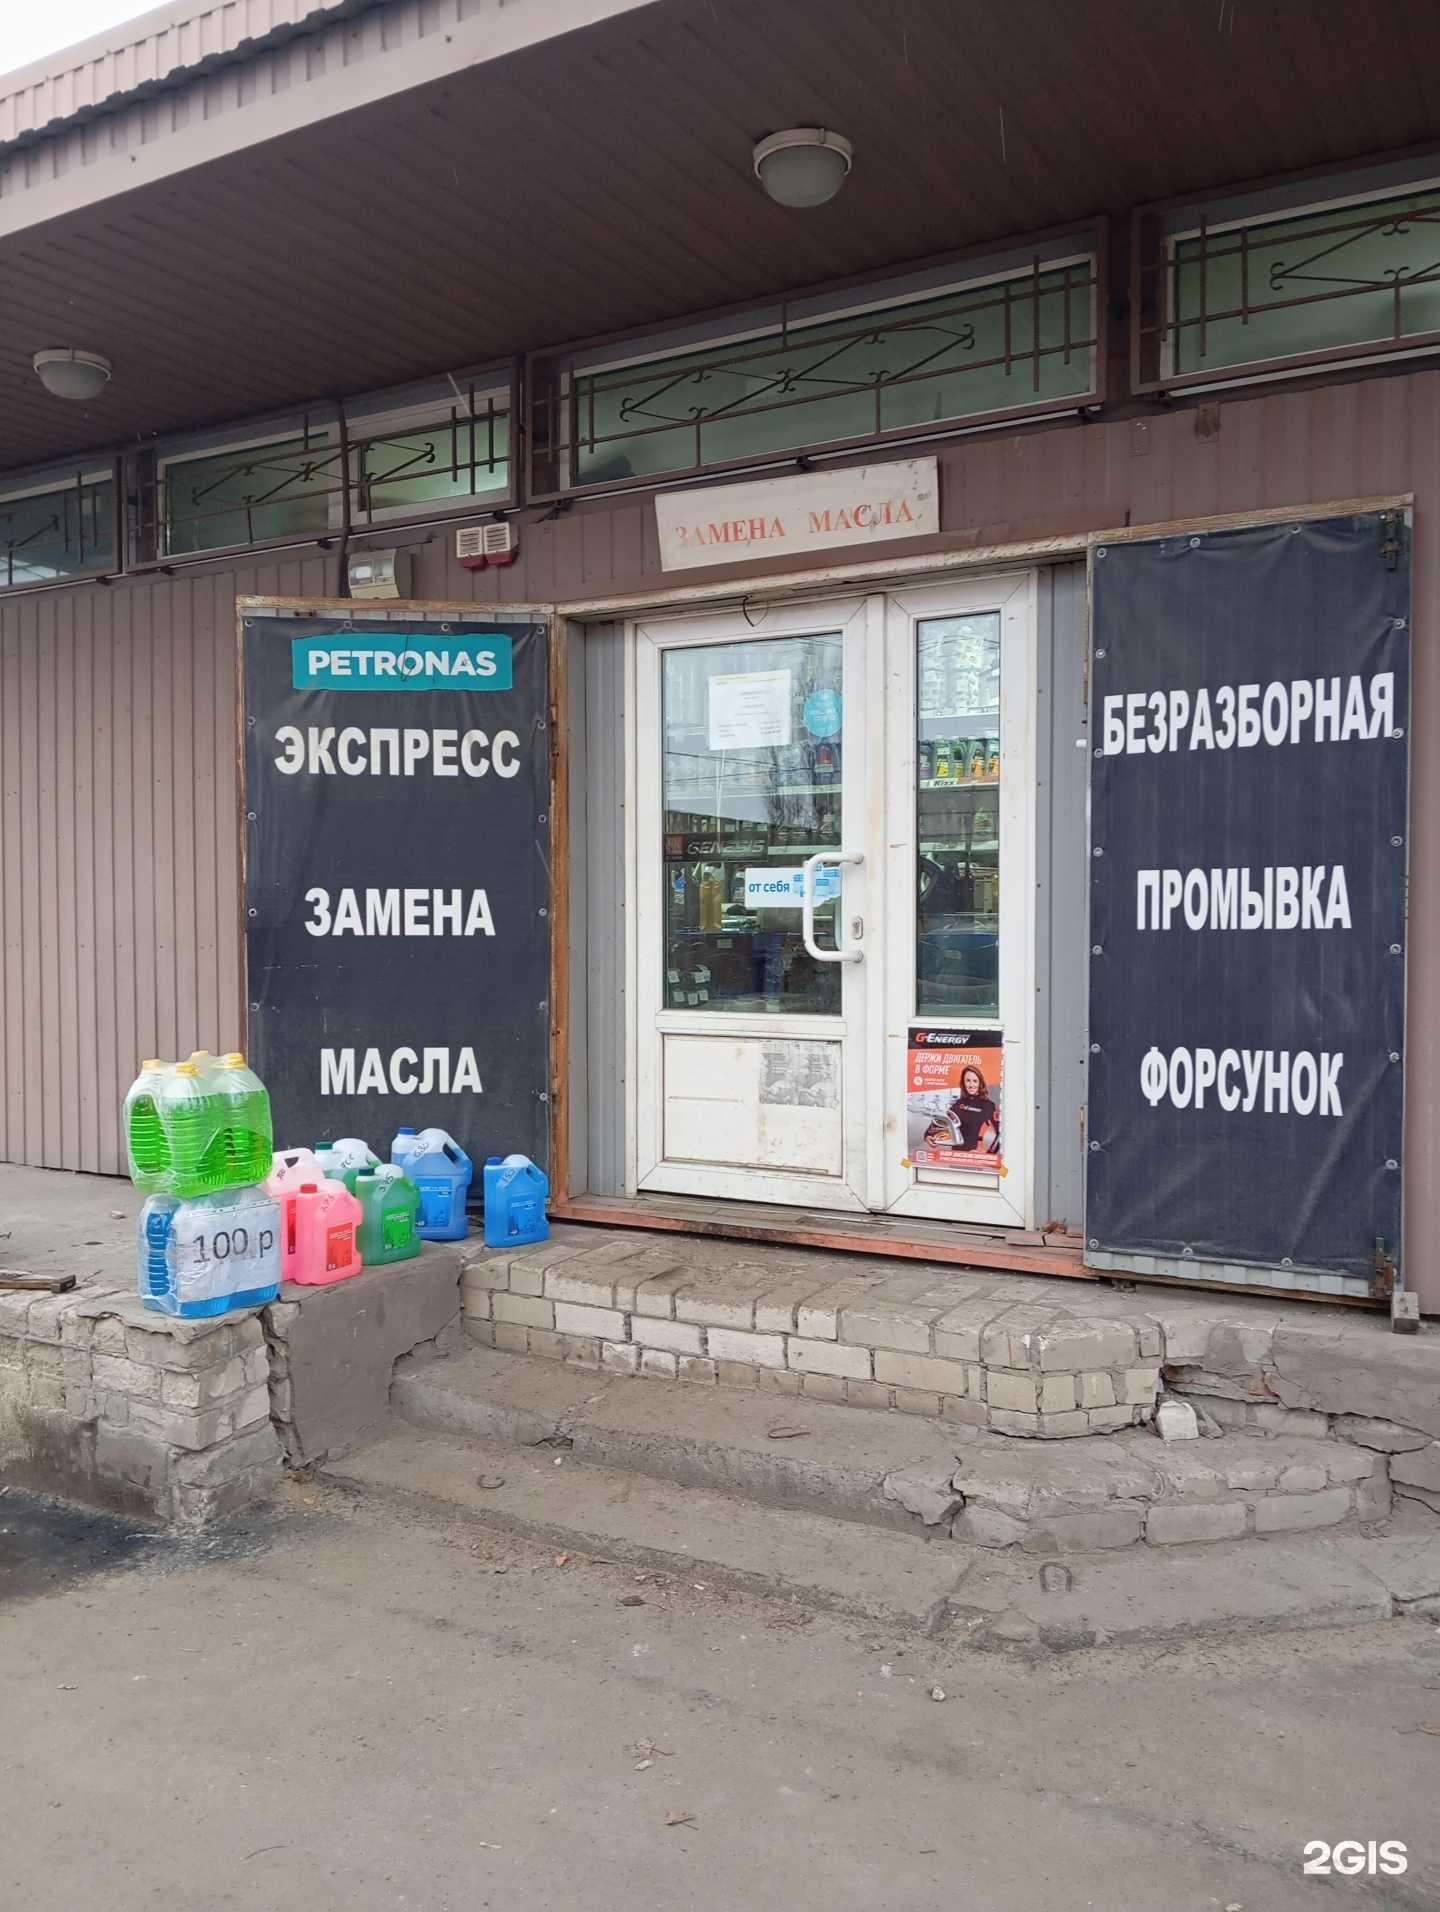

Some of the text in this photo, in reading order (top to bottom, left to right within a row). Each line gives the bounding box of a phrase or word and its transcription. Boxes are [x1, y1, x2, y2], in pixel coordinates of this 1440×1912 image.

[675, 499, 913, 546] ЗАМЕНА МАСЛА
[307, 649, 498, 678] PETRONAS
[1103, 672, 1395, 756] БЕЗРАЗБОРНАЯ
[274, 725, 521, 779] ЭКСПРЕСС
[749, 880, 790, 893] от себя
[1136, 865, 1352, 931] ПРОМЫВКА
[304, 887, 496, 937] ЗАМЕНА
[320, 1046, 484, 1096] МАСЛА
[923, 1065, 950, 1075] ФОРМЕ
[942, 1054, 982, 1065] ДВИГАТЕЛЬ
[1140, 1046, 1344, 1117] ФОРСУНОК
[193, 1228, 248, 1263] 100
